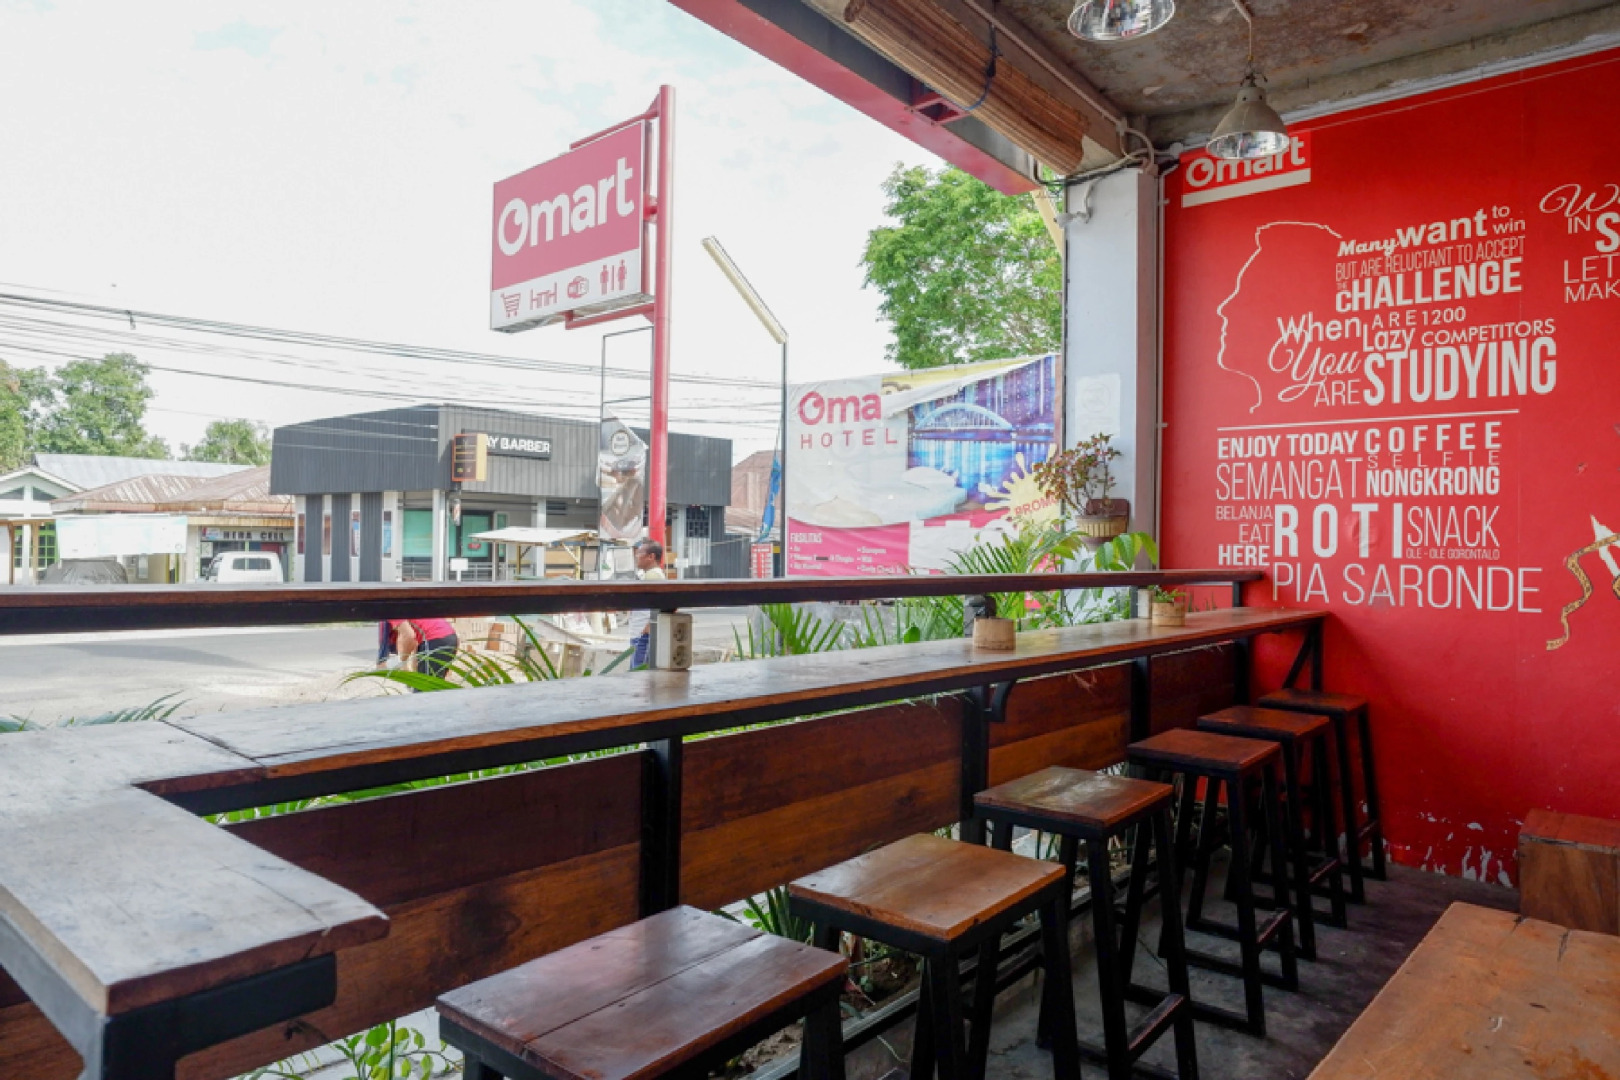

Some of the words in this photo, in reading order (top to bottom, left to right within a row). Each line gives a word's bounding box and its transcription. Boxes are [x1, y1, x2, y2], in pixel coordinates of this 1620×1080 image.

[498, 157, 634, 256] Omart
[1492, 205, 1510, 219] to
[1539, 183, 1620, 218] W
[1337, 236, 1399, 257] Many
[1396, 208, 1487, 248] want
[1493, 218, 1526, 235] win
[1567, 214, 1591, 234] IN
[1336, 260, 1358, 281] BUT
[1359, 254, 1383, 278] ARE
[1385, 245, 1454, 273] RELUCTANT
[1457, 244, 1474, 264] TO
[1475, 236, 1526, 262] ACCEPT
[1336, 257, 1523, 313] CHALLENGE
[1277, 312, 1363, 344] When
[1372, 310, 1417, 329] ARE
[1422, 306, 1467, 325] 1200
[1362, 326, 1416, 353] Lazy
[1421, 318, 1555, 347] COMPETITORS
[1268, 330, 1362, 402] You
[1364, 336, 1557, 407] STUDYING
[799, 391, 881, 426] Oma
[1314, 379, 1361, 407] ARE
[500, 437, 550, 454] BARBER
[800, 428, 898, 450] HOTEL
[1218, 435, 1281, 460] ENJOY
[1285, 430, 1359, 457] TODAY
[1365, 422, 1503, 454] COFFEE
[1367, 450, 1501, 468] SELFIE
[1216, 457, 1363, 501] SEMANGAT
[1366, 466, 1500, 498] NONGKRONG
[1216, 505, 1274, 521] BELANJA
[1407, 505, 1500, 548] SNACK
[1239, 523, 1272, 544] EAT
[1274, 503, 1403, 559] ROTI
[1218, 544, 1270, 567] HERE
[1406, 548, 1422, 559] OLE
[1429, 548, 1446, 559] OLE
[1447, 548, 1500, 561] GORONTALO
[1274, 562, 1330, 604] PIA
[1342, 564, 1543, 614] SARONDE
